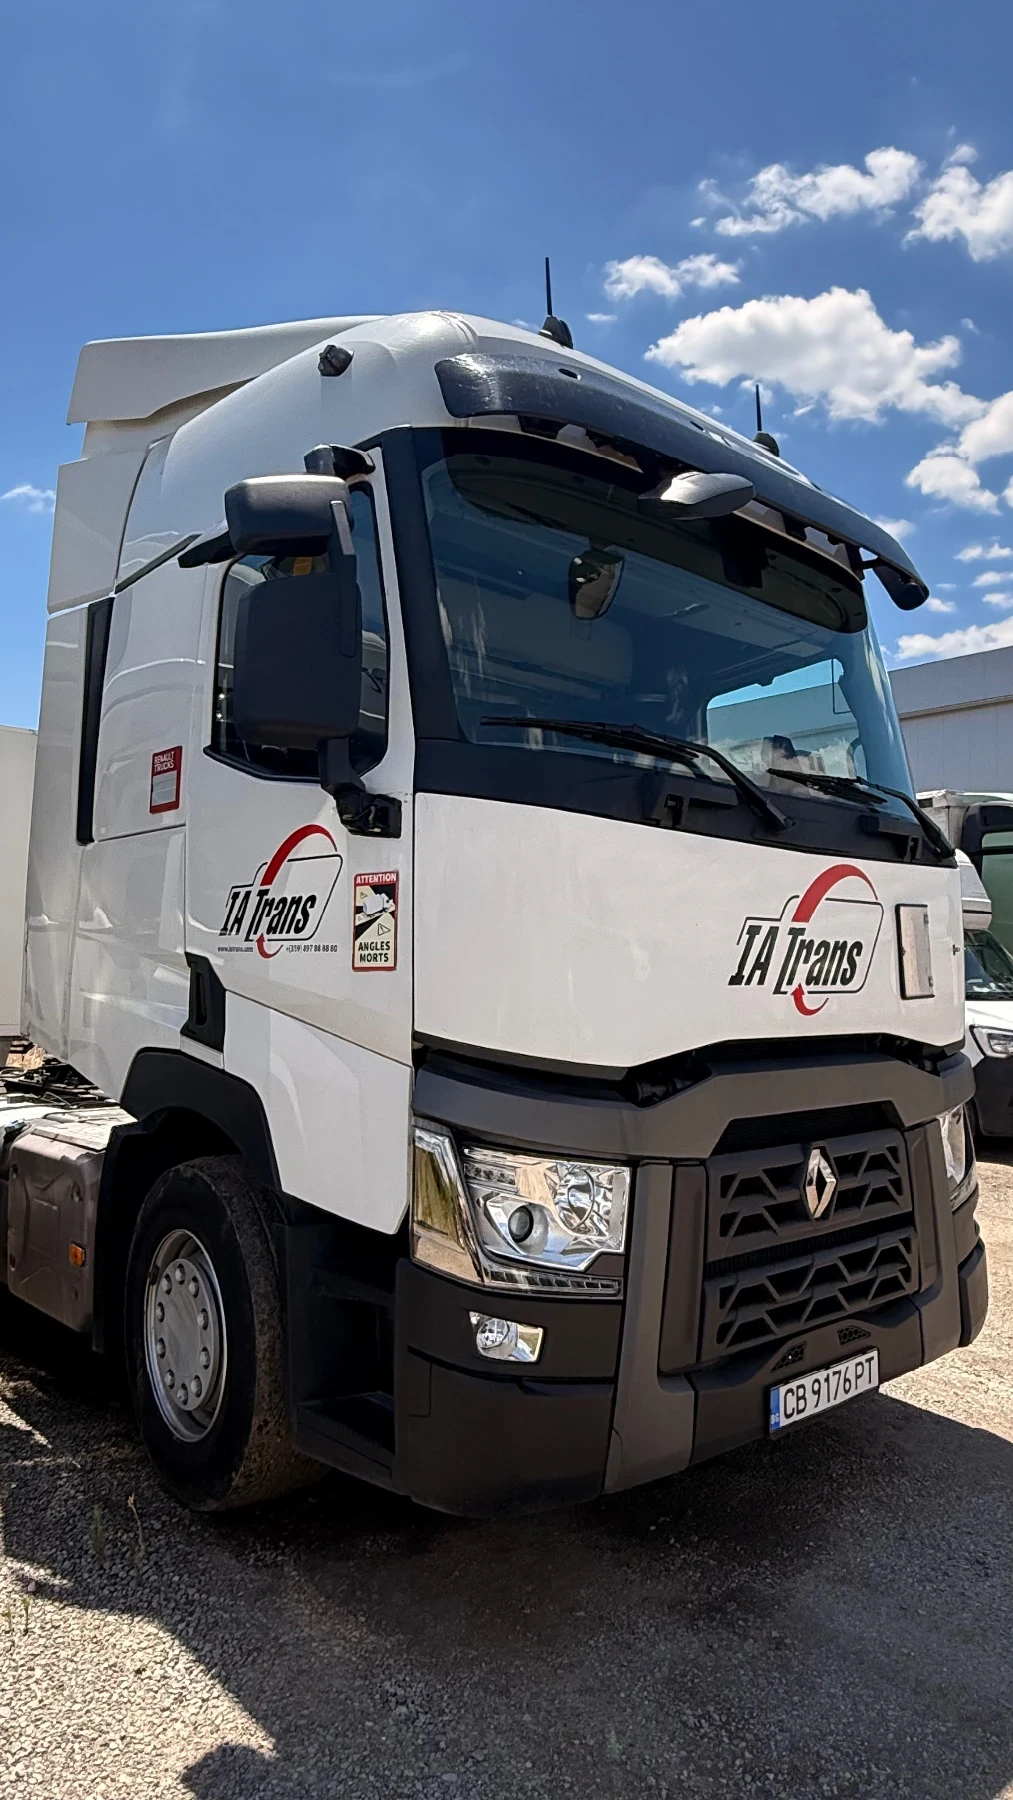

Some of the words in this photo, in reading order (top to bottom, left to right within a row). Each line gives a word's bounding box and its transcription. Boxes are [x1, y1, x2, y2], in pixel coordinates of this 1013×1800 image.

[154, 751, 175, 764] RENAULT
[154, 761, 174, 772] TRUCKS
[356, 873, 397, 884] ATTENTION
[219, 890, 252, 936] IA
[244, 889, 317, 942] Trans
[358, 941, 391, 951] ANGLES
[359, 953, 389, 963] MORTS
[728, 925, 779, 986] IA
[773, 927, 863, 995] Trans
[783, 1383, 808, 1420] CB
[811, 1366, 852, 1408] 9176
[854, 1356, 875, 1390] PT
